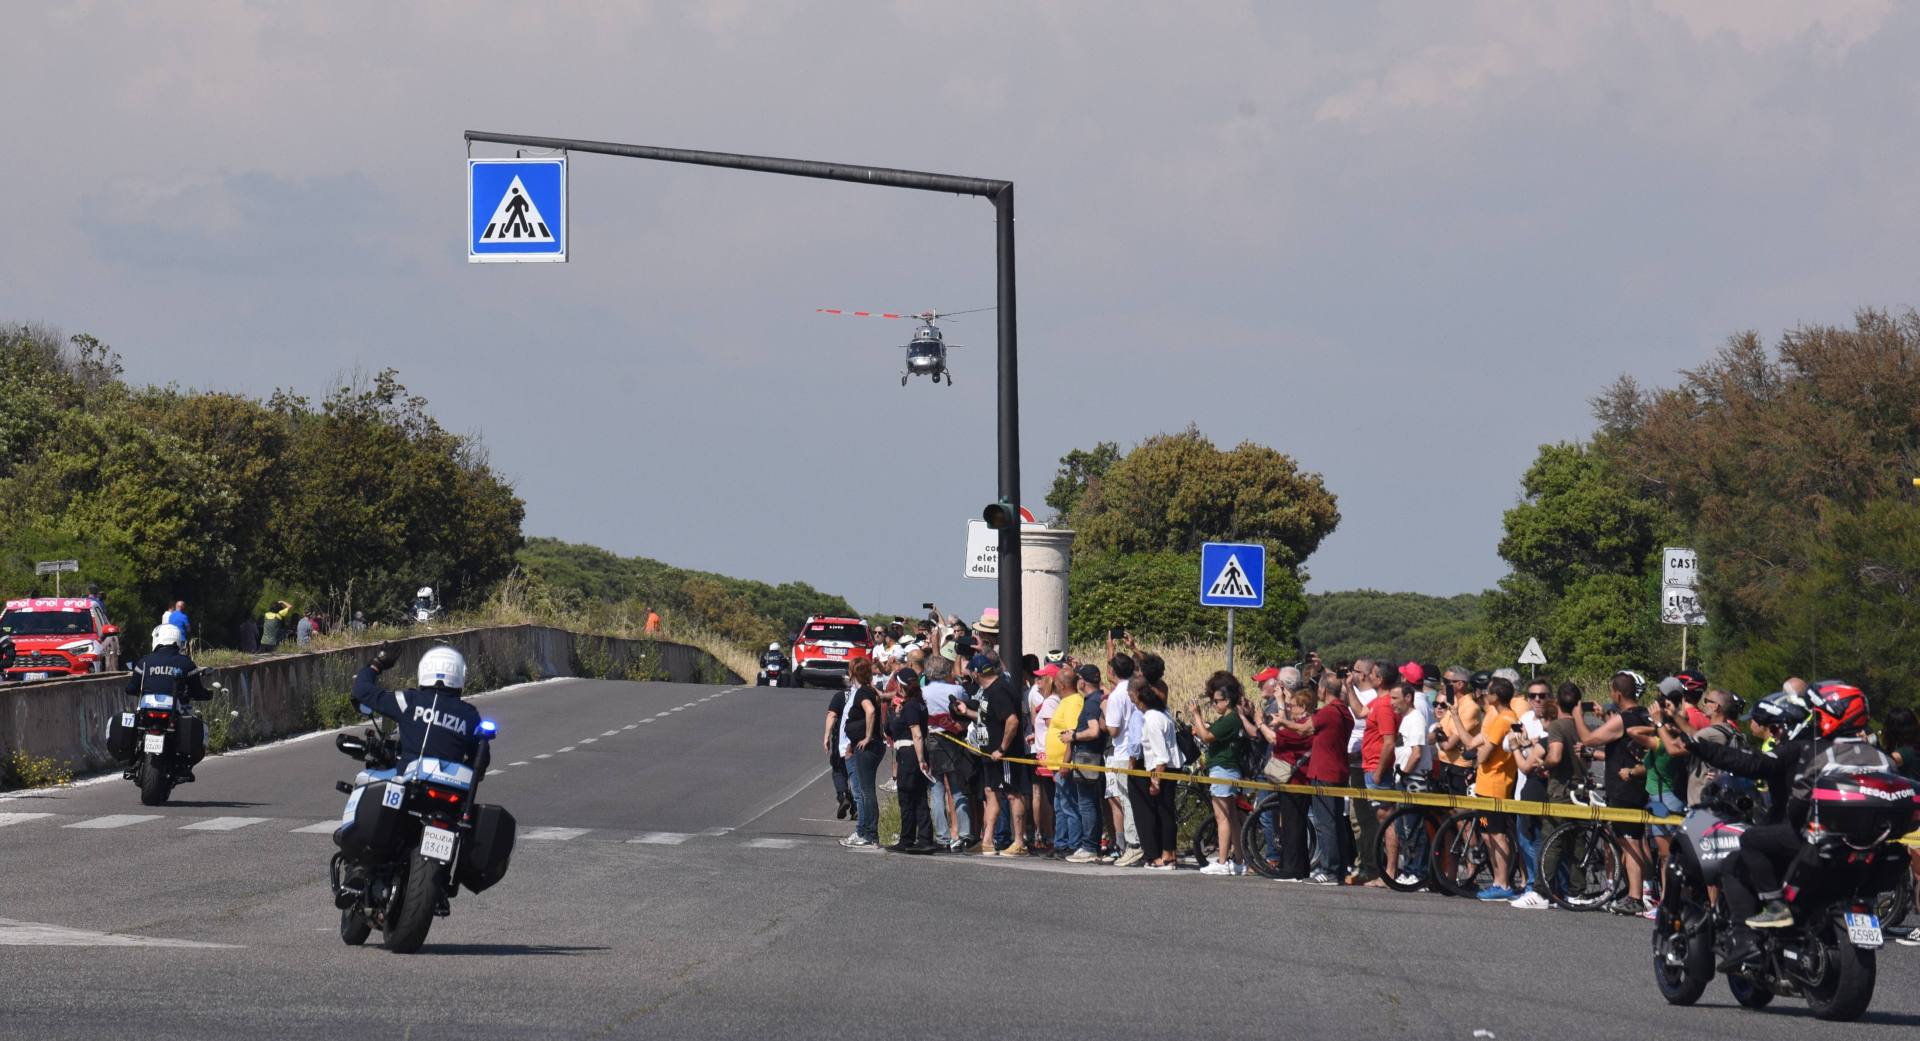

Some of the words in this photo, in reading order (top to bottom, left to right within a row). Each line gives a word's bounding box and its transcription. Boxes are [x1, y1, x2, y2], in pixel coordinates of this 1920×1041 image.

[972, 564, 996, 574] della
[7, 600, 29, 608] enel
[124, 717, 132, 725] 17
[413, 705, 467, 735] POLIZIA
[386, 790, 400, 806] 18
[1859, 786, 1915, 802] REGOLATORE
[424, 831, 453, 843] POLIZIA
